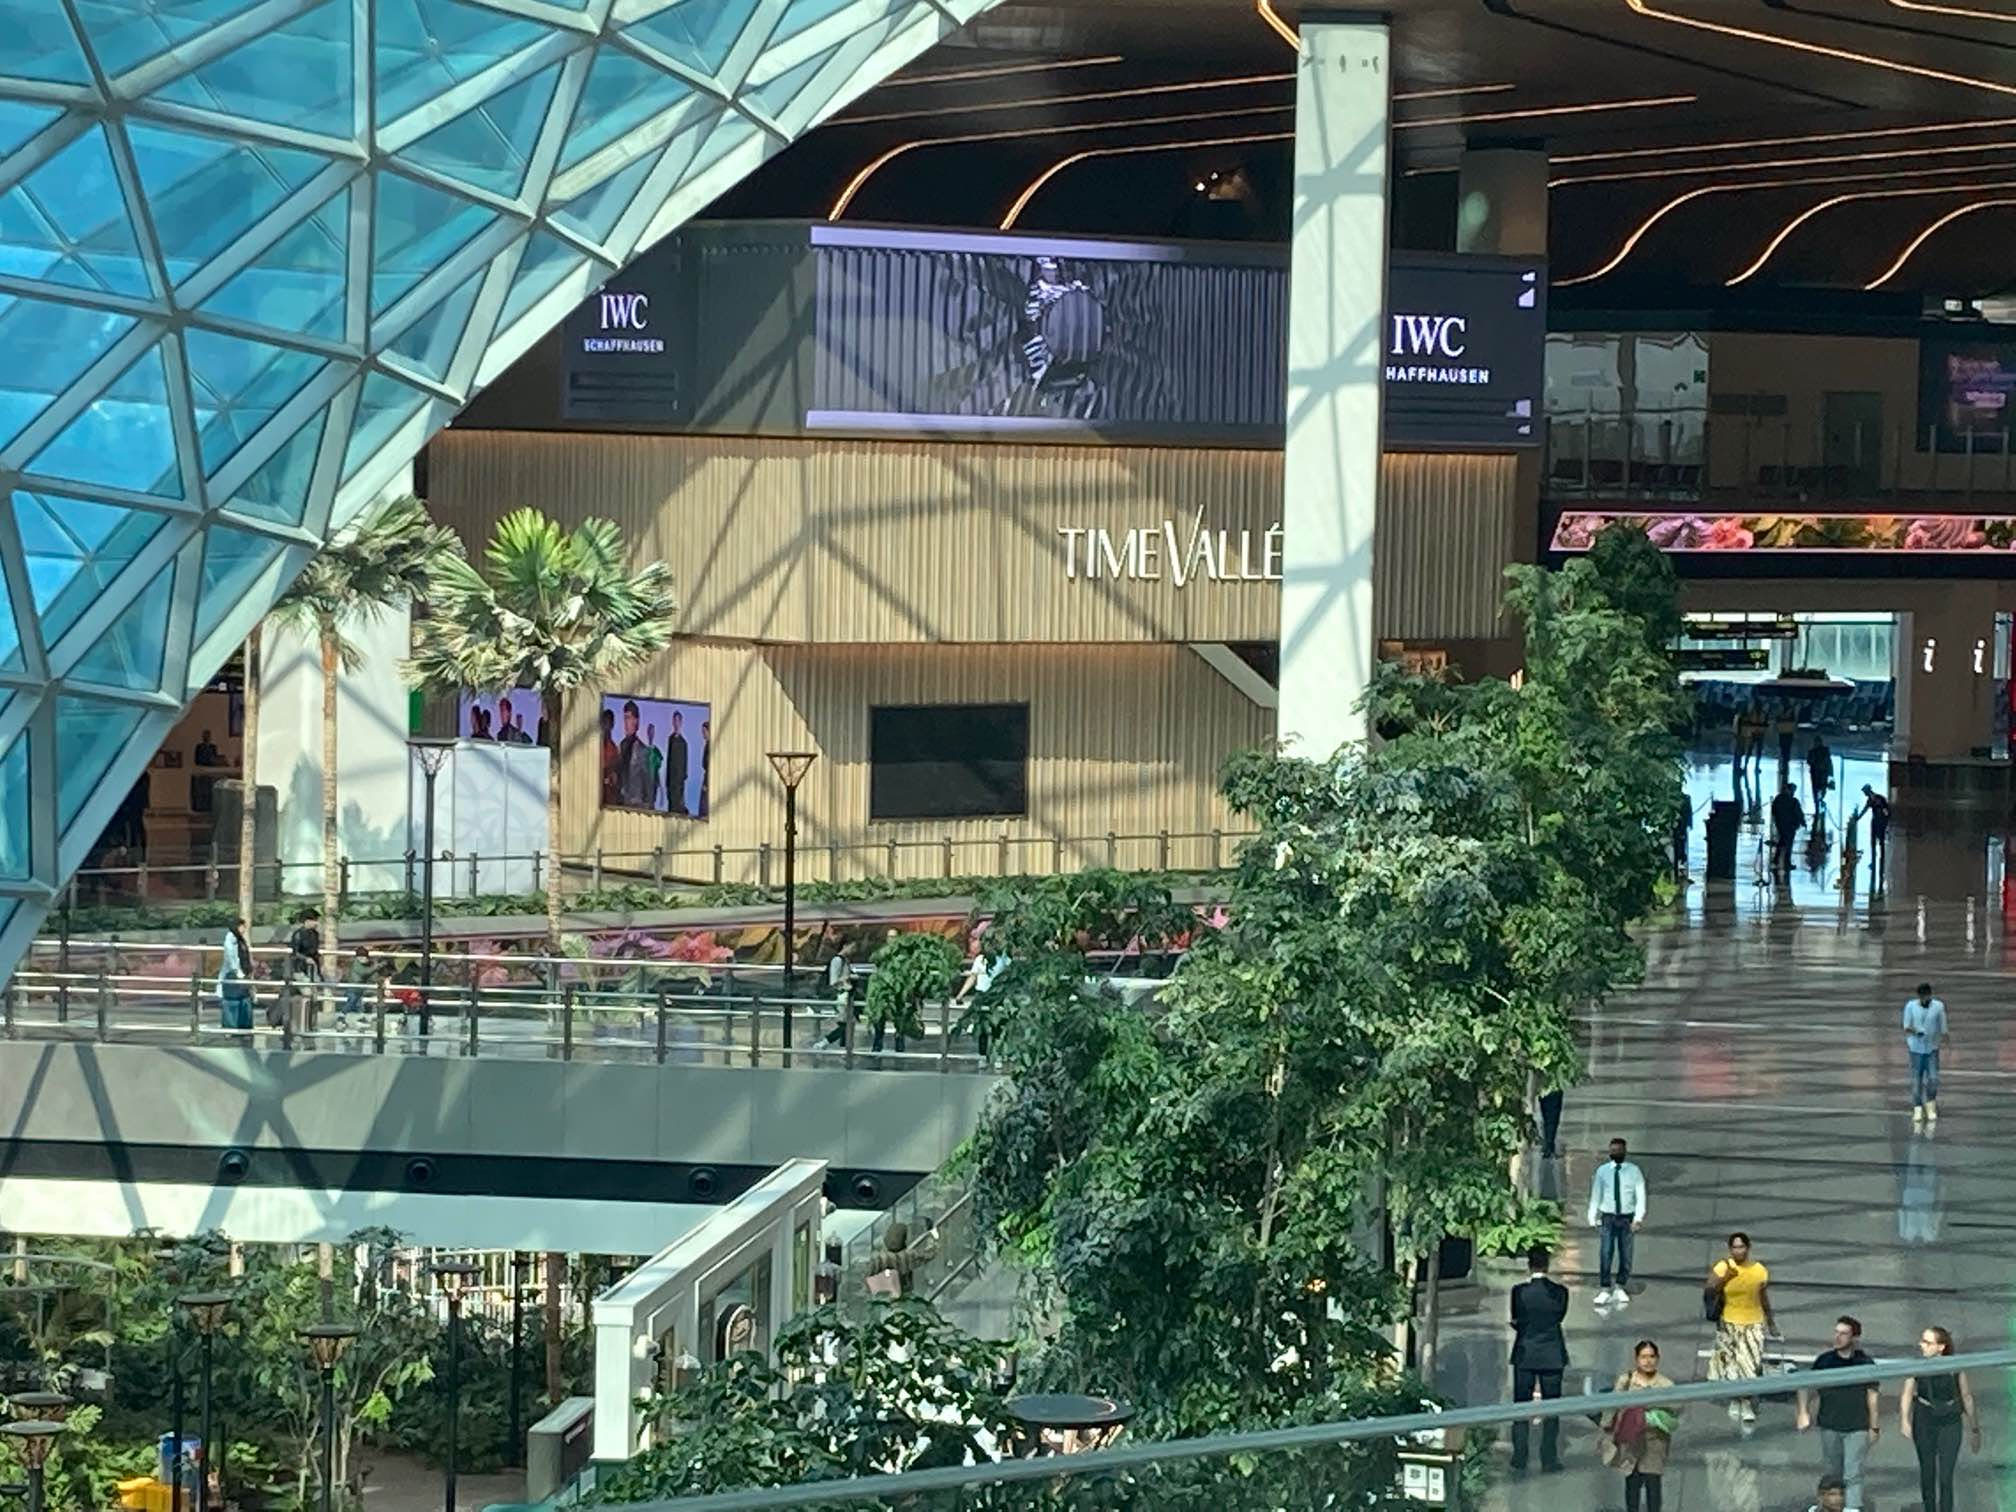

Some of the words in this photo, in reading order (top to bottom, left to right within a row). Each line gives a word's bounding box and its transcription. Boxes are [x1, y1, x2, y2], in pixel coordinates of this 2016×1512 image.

[601, 294, 648, 329] IWC
[1390, 315, 1466, 357] IWC
[1386, 366, 1489, 383] HAFFHAUSEN
[1058, 504, 1284, 588] TIMEVALLÉ
